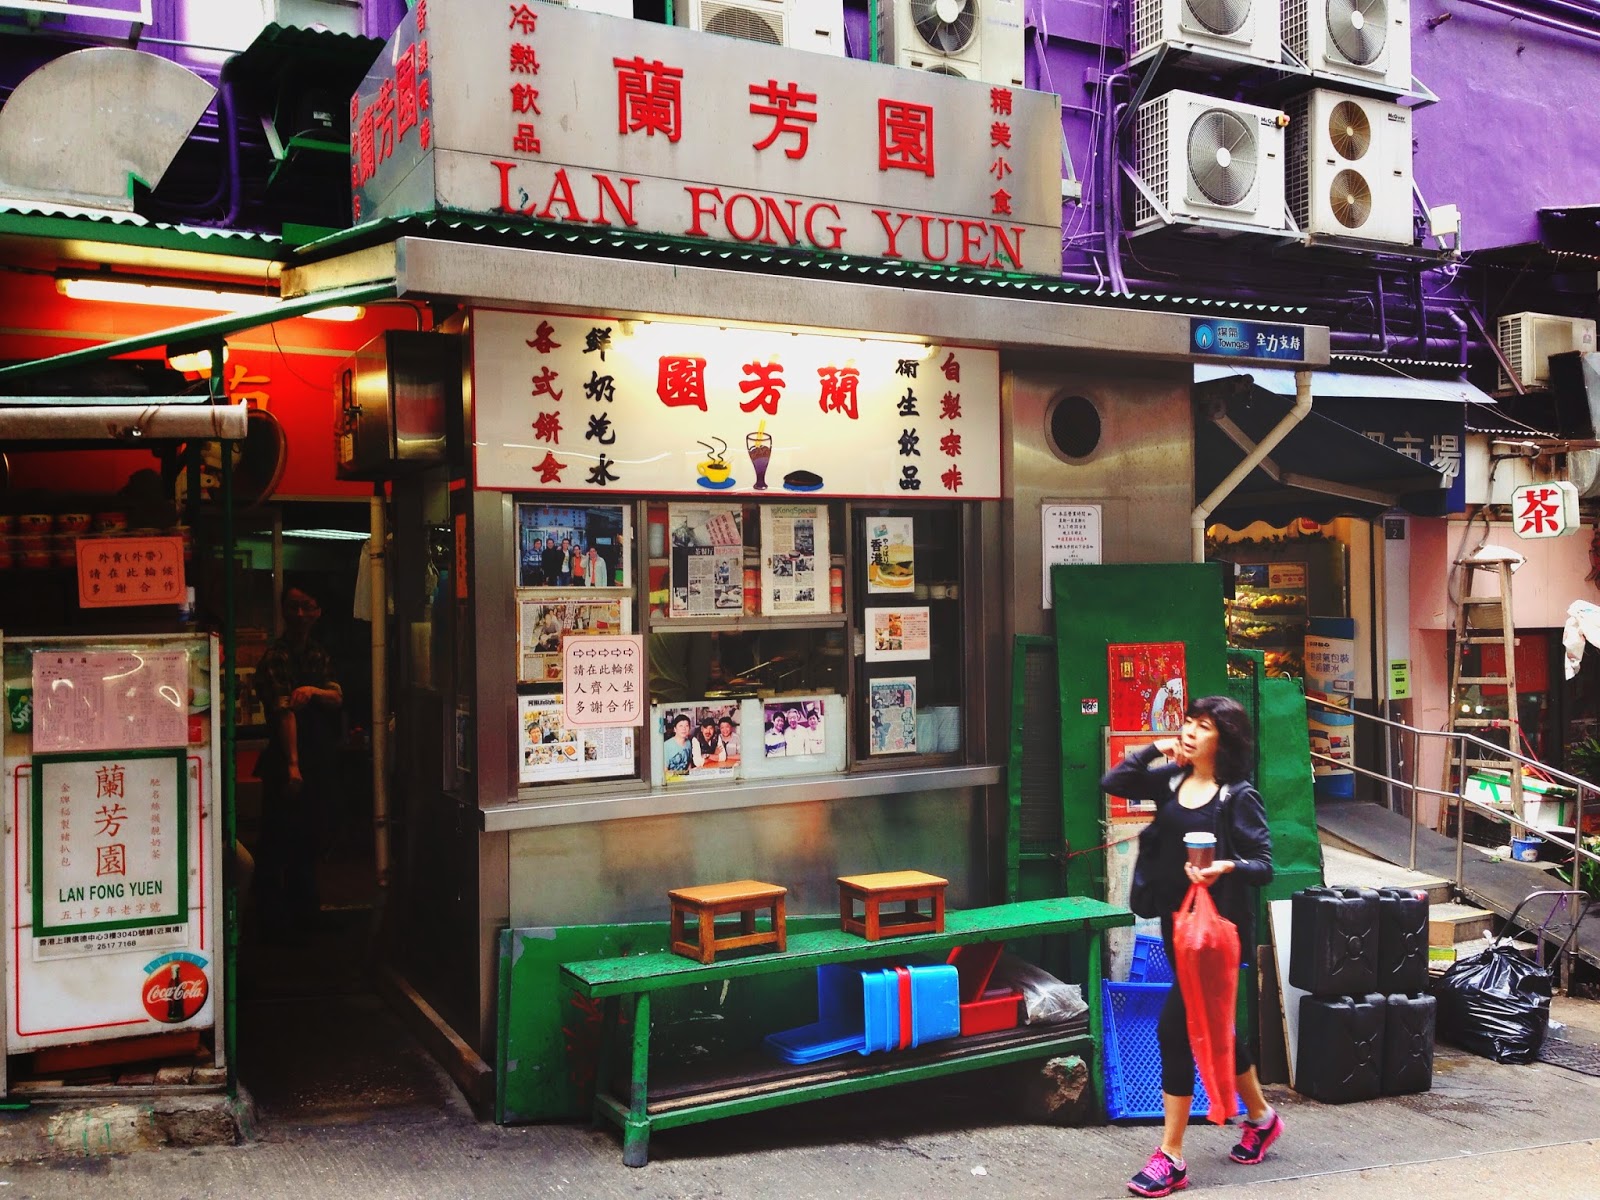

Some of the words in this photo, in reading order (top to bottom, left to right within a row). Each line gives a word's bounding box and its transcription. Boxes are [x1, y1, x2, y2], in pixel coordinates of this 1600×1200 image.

[508, 3, 542, 154] 冷熱飲品
[358, 42, 418, 188] 蘭芳園
[612, 55, 935, 178] 蘭芳園
[989, 87, 1013, 216] 精美小食
[490, 160, 641, 227] LAN
[684, 186, 848, 250] FONG
[871, 209, 1026, 269] YUEN
[1218, 338, 1250, 350] Towngas
[1256, 332, 1301, 353] 全力支持
[525, 320, 568, 484] 各式餅食
[582, 326, 620, 486] 鮮奶汽水
[1517, 489, 1560, 534] 茶
[1392, 528, 1398, 538] 2
[92, 581, 174, 596] 多謝合作
[573, 663, 635, 677] 請在此輪候
[574, 680, 635, 695] 人齊入坐
[574, 698, 635, 716] 多謝合作
[94, 763, 129, 877] 蘭芳園
[59, 886, 85, 903] LAN
[89, 883, 125, 900] FONG
[129, 879, 163, 897] YUEN
[60, 902, 162, 921] 五十多年老字號
[146, 979, 205, 1004] Coca-Cola
